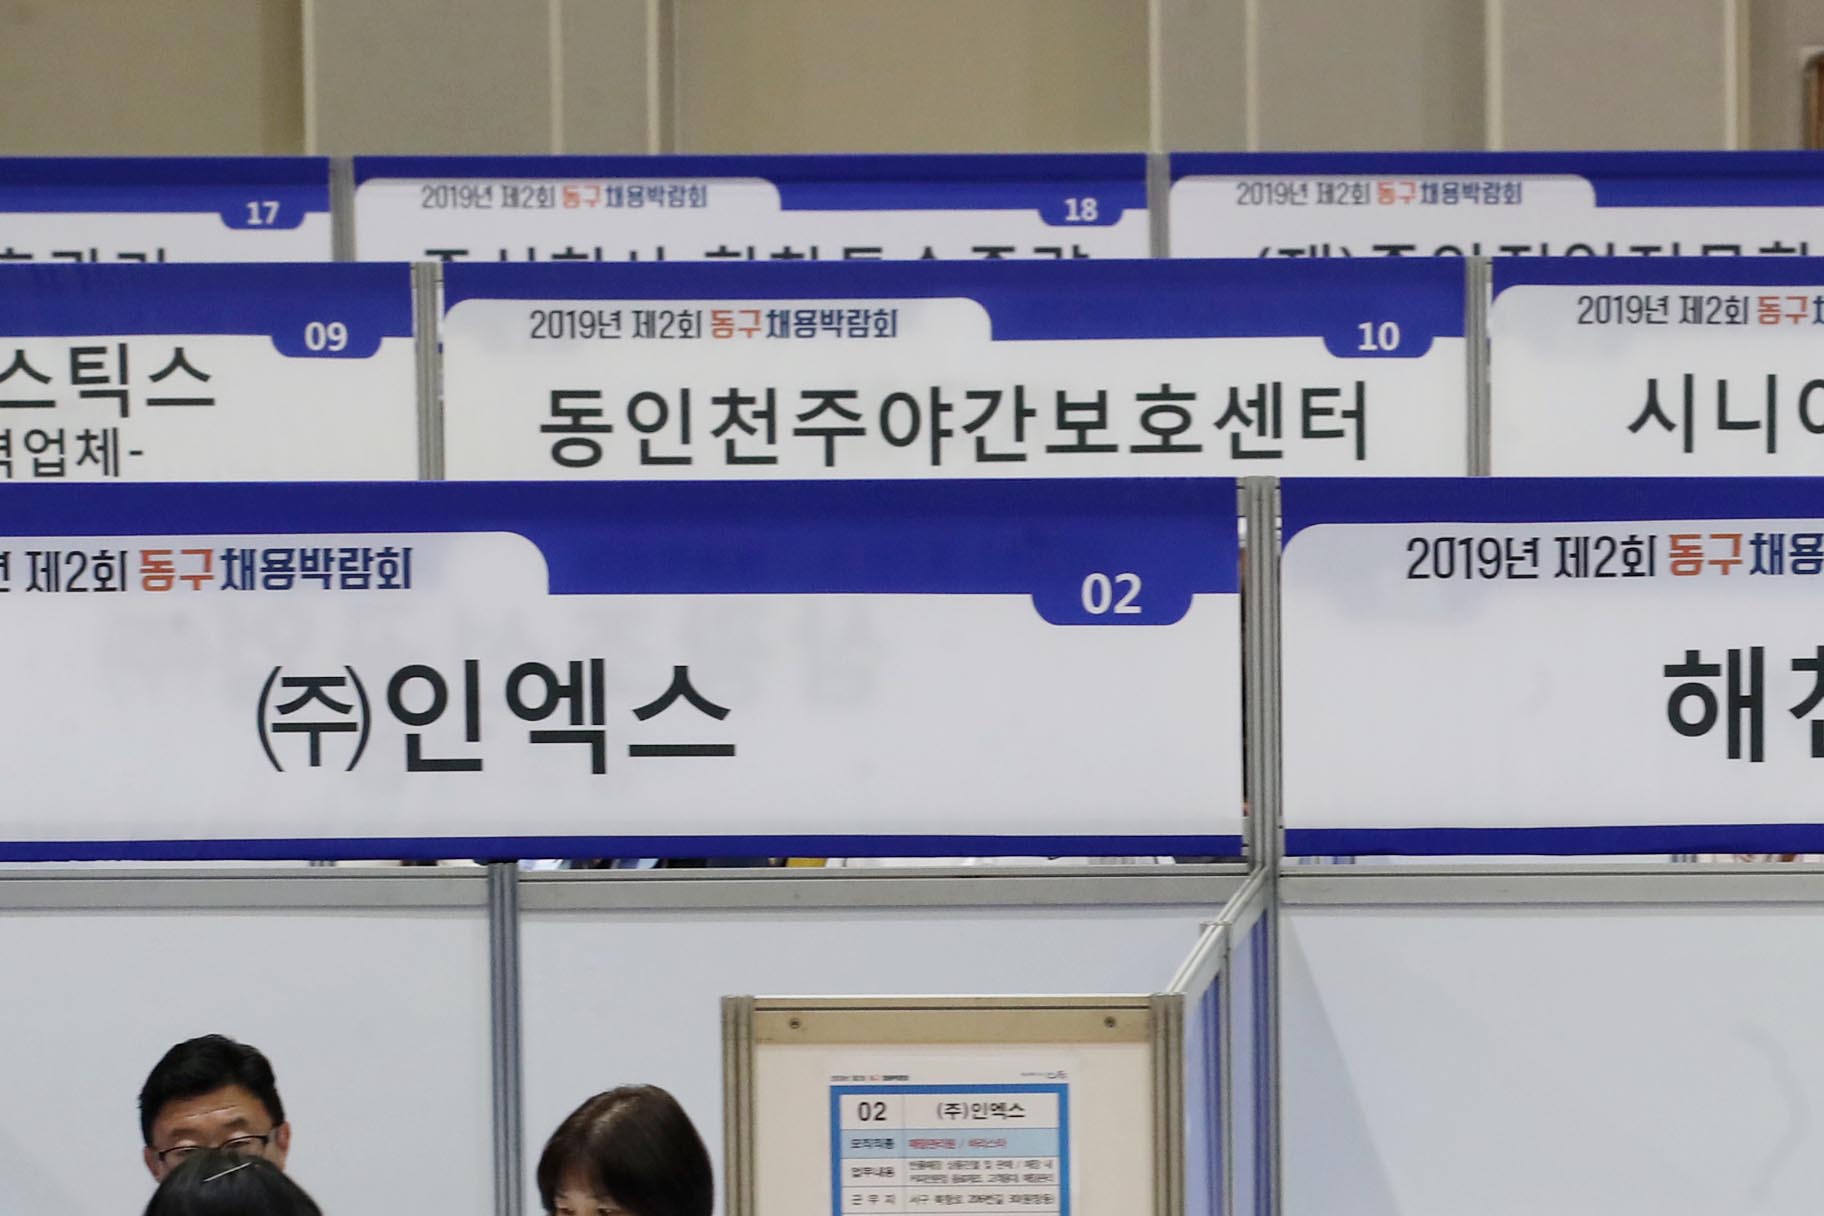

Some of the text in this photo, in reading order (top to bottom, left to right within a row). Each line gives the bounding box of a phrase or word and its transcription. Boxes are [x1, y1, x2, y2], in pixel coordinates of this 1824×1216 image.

[421, 185, 492, 209] 2019년
[501, 185, 555, 208] 제2회
[1237, 182, 1307, 206] 2019년
[1316, 182, 1371, 205] 제2회
[246, 201, 279, 224] 17
[1065, 198, 1098, 221] 18
[530, 310, 621, 340] 2019년
[632, 309, 701, 339] 제2회
[1577, 296, 1669, 325] 2019년
[1679, 295, 1748, 325] 제2회
[304, 322, 348, 351] 09
[1357, 321, 1399, 351] 10
[0, 343, 215, 418] 스틱스
[540, 382, 1366, 468] 동인천주야간보호센터
[1406, 537, 1540, 579] 2019년
[1554, 535, 1657, 577] 제2회
[25, 551, 128, 594] 제2회
[1081, 573, 1142, 614] 02
[857, 1102, 887, 1122] 02
[937, 1102, 1026, 1121] (주)인엑스
